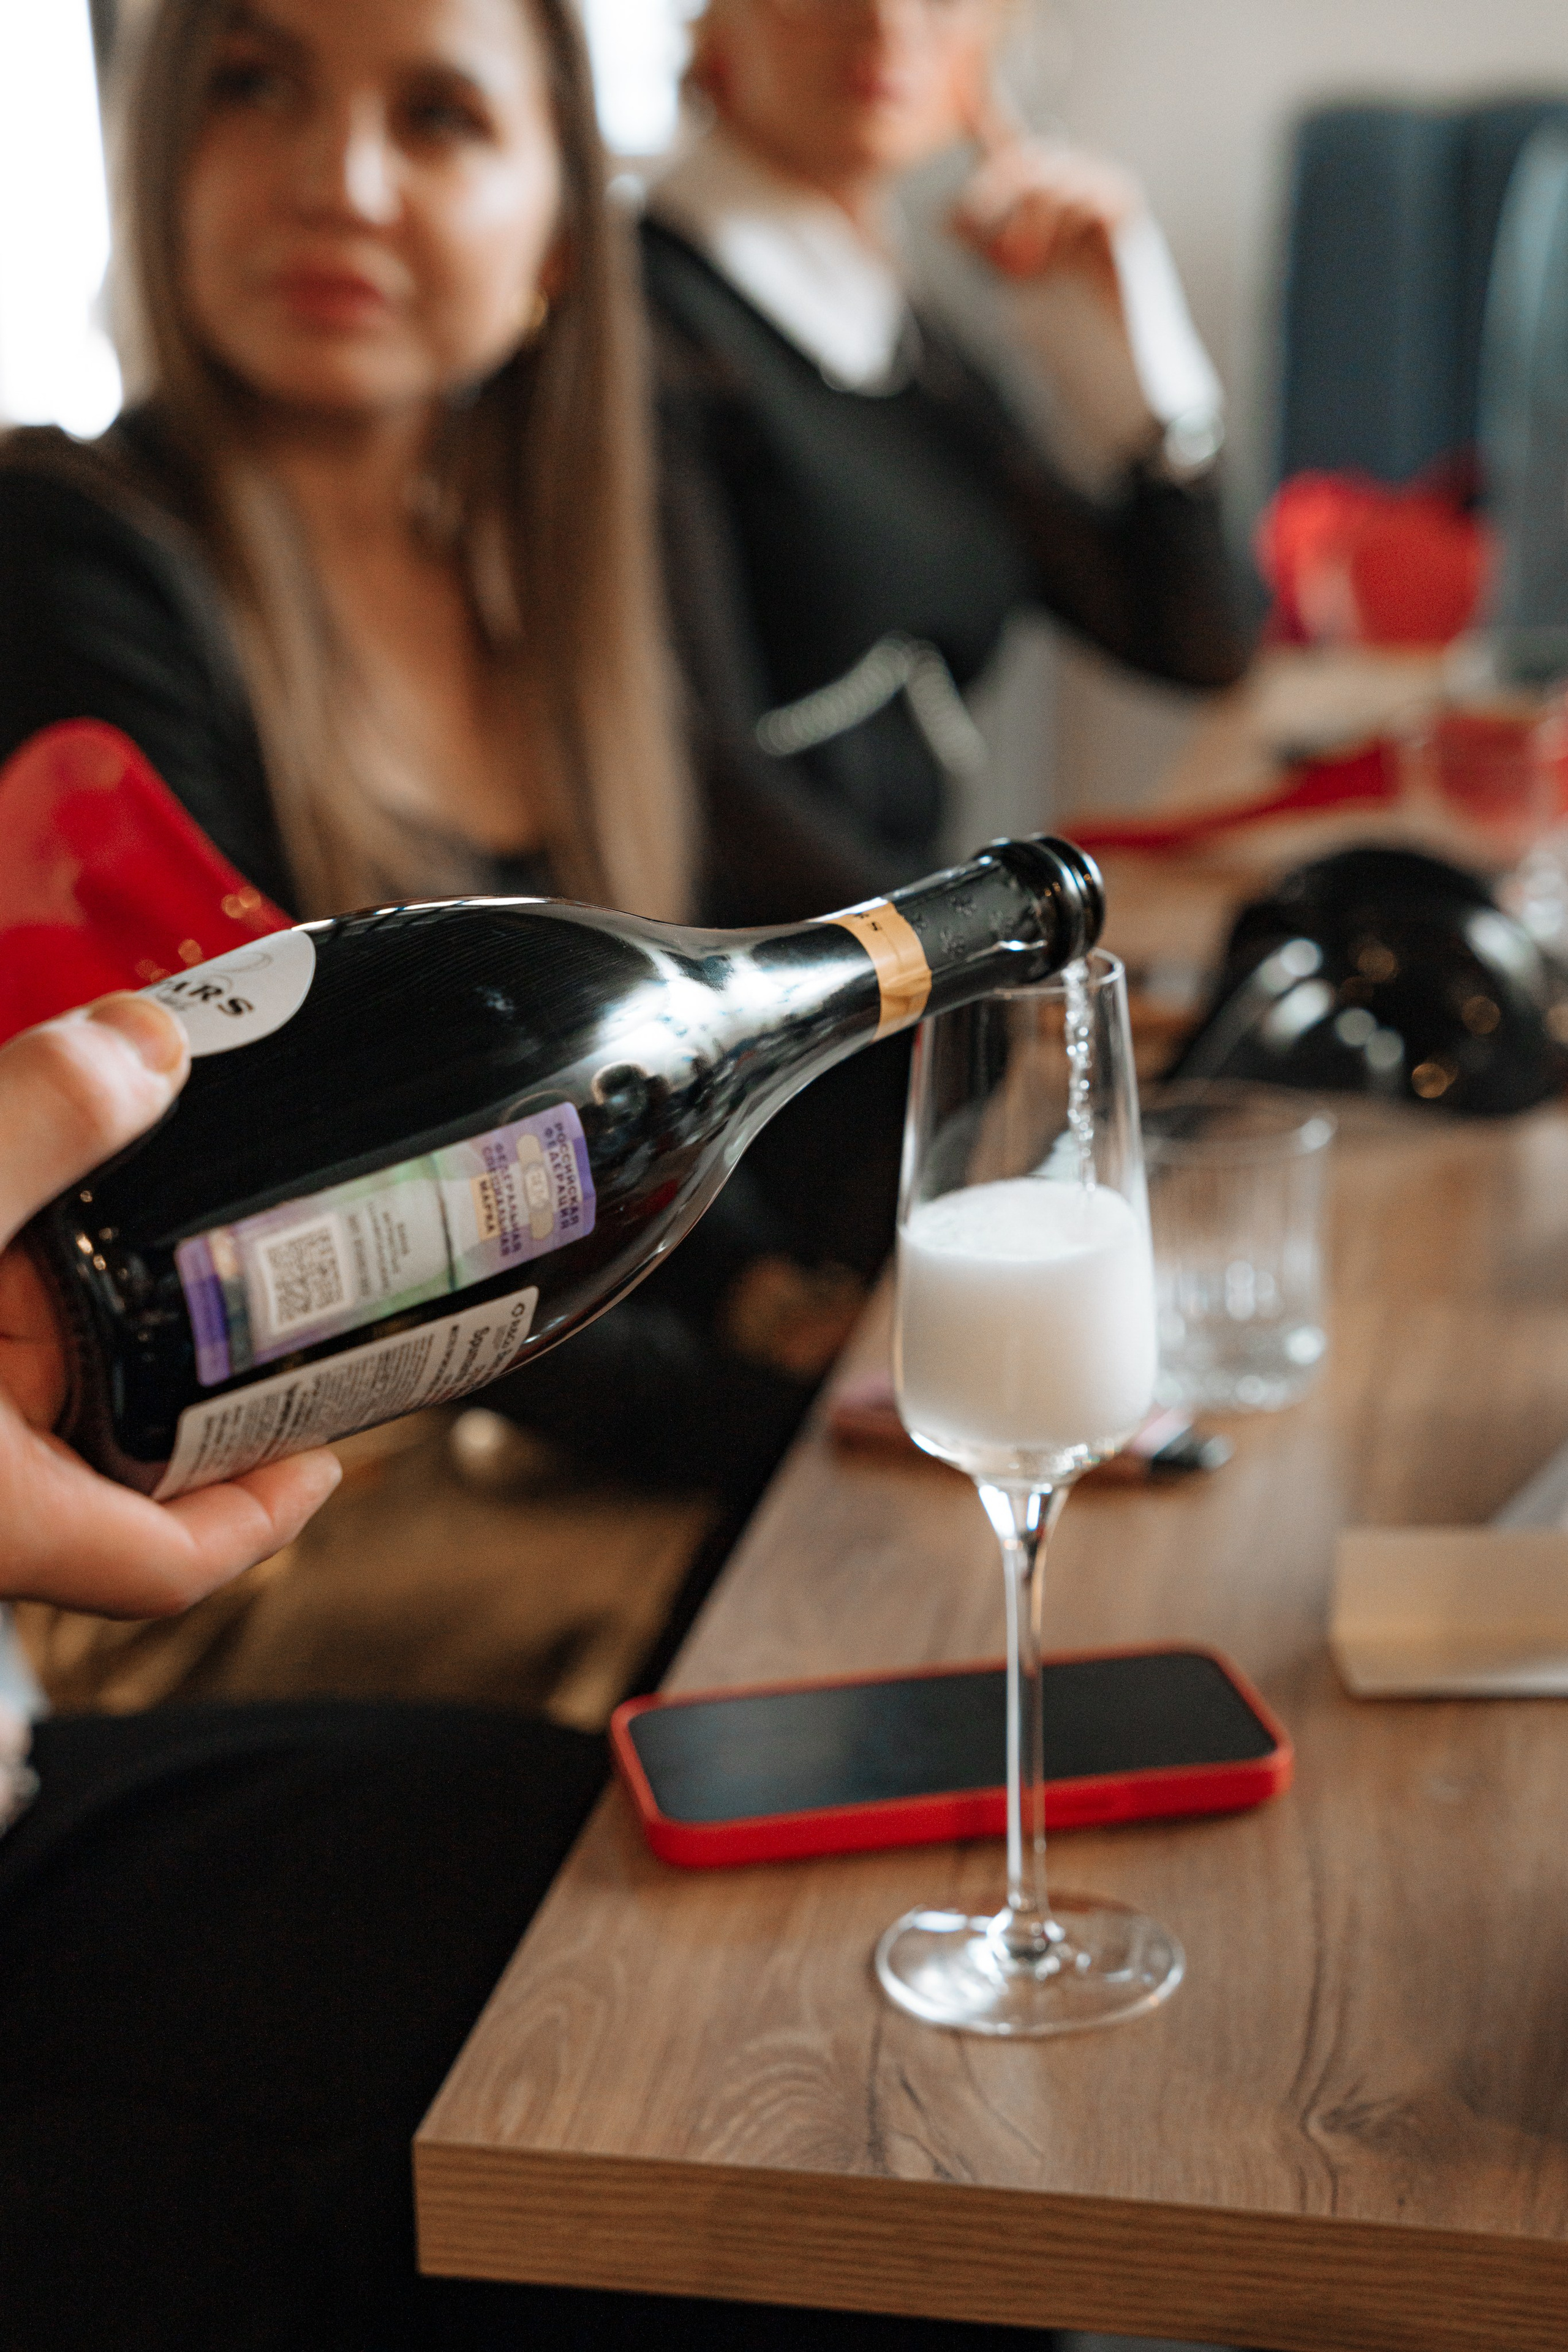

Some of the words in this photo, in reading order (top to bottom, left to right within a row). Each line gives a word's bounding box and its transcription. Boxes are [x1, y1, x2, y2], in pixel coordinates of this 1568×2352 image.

[480, 1181, 495, 1232] МАРКА
[545, 1128, 570, 1229] ФЕДЕРАЦИЯ
[555, 1122, 579, 1226] РОССИЙСКАЯ
